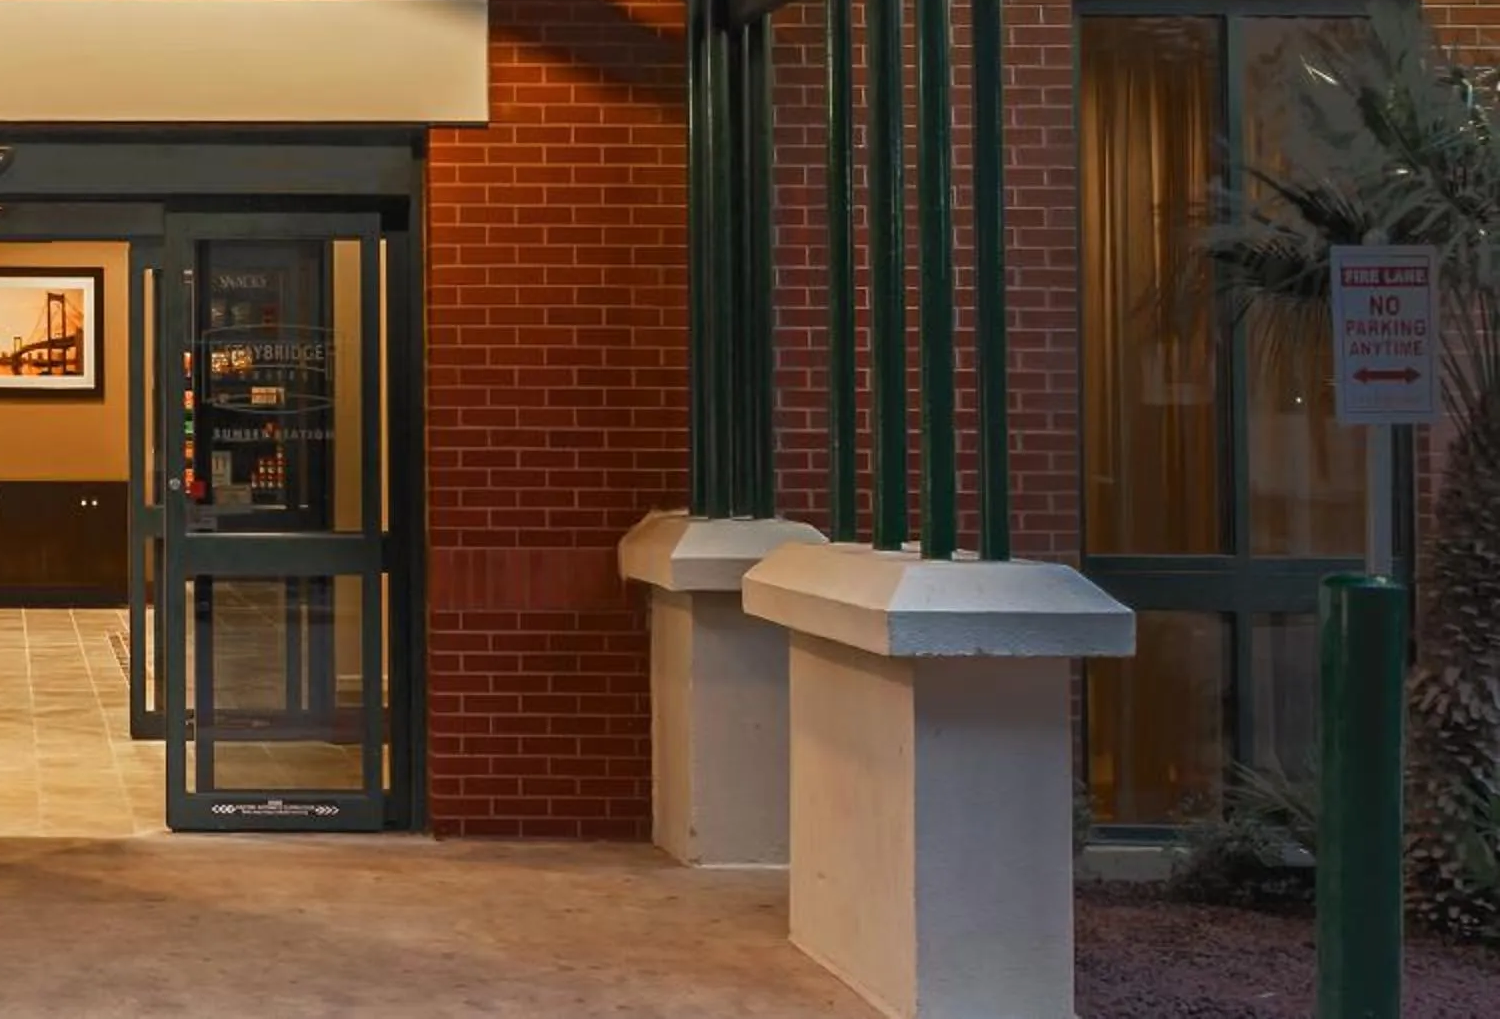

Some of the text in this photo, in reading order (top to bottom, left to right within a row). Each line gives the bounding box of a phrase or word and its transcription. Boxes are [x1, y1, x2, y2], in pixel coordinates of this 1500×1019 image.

[1344, 268, 1426, 283] FIRE LANE
[1370, 296, 1400, 316] NO
[1345, 320, 1426, 337] PARKING
[1349, 340, 1424, 357] ANYTIME
